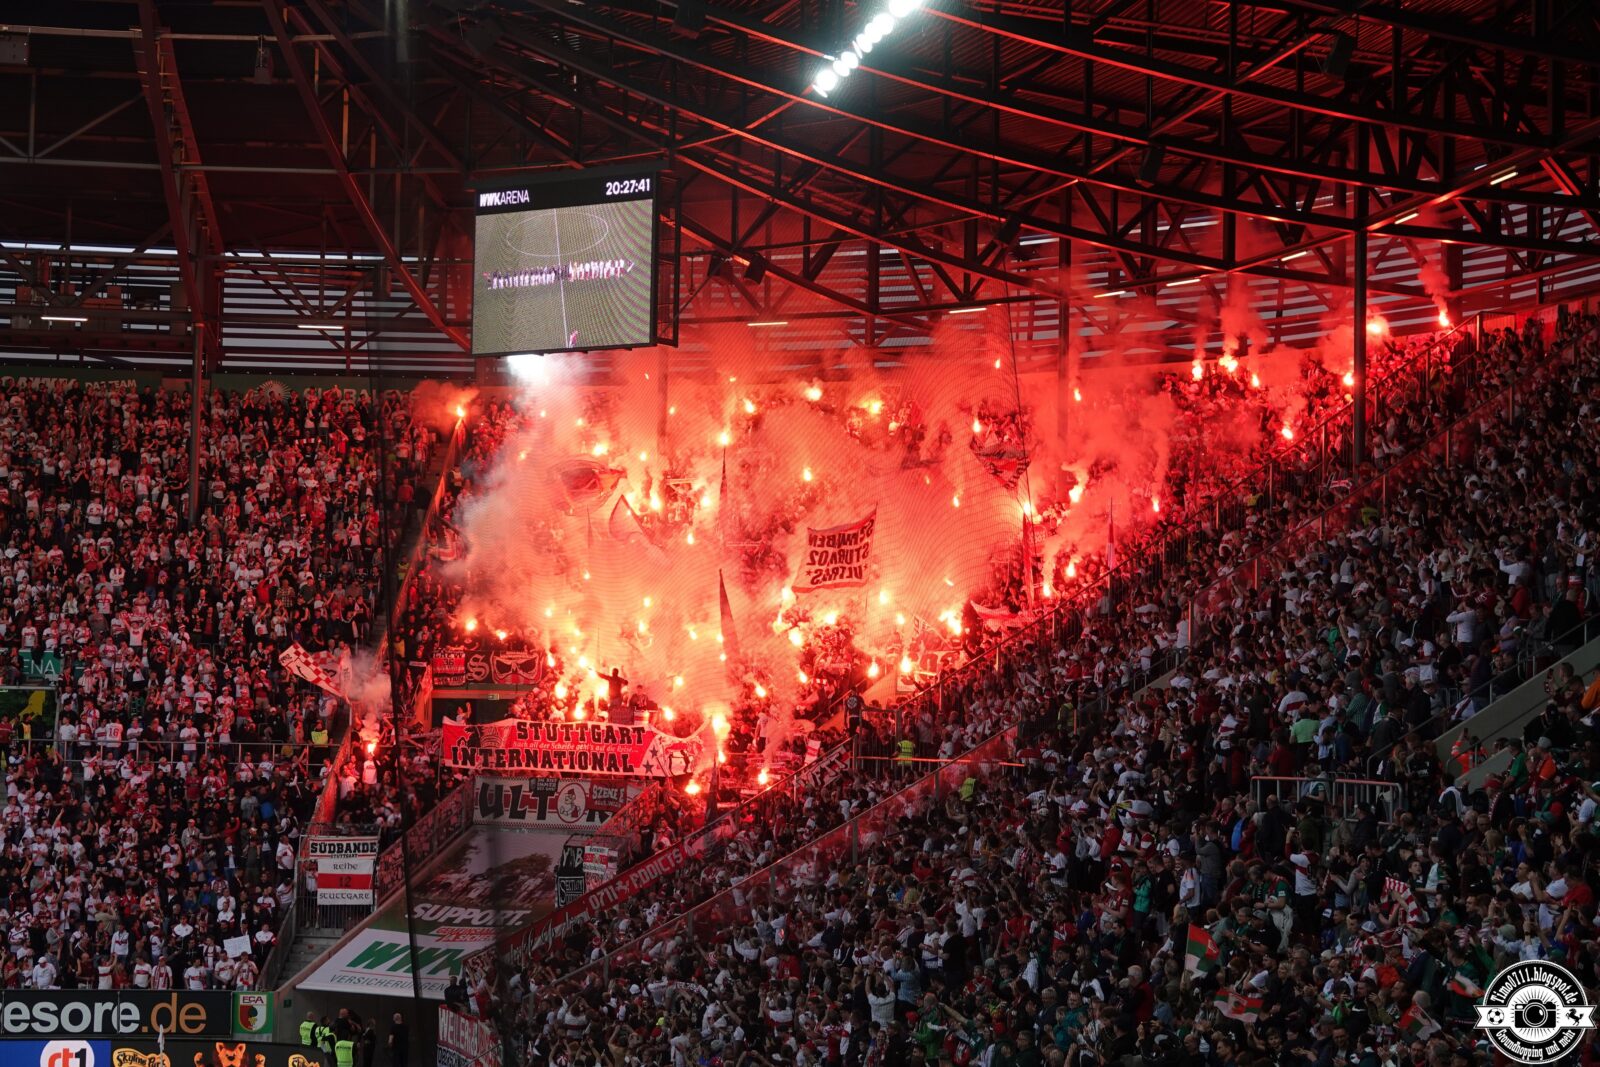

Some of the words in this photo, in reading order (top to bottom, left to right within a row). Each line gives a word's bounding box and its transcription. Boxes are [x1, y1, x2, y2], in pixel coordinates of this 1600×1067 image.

[606, 178, 650, 195] 20:27:41
[516, 721, 646, 744] STUTTGART
[452, 746, 634, 773] INTERNATIONAL
[310, 841, 377, 854] SÜDBANDE
[588, 885, 618, 910] 0711
[346, 940, 465, 976] WWK
[0, 993, 207, 1033] esore.de
